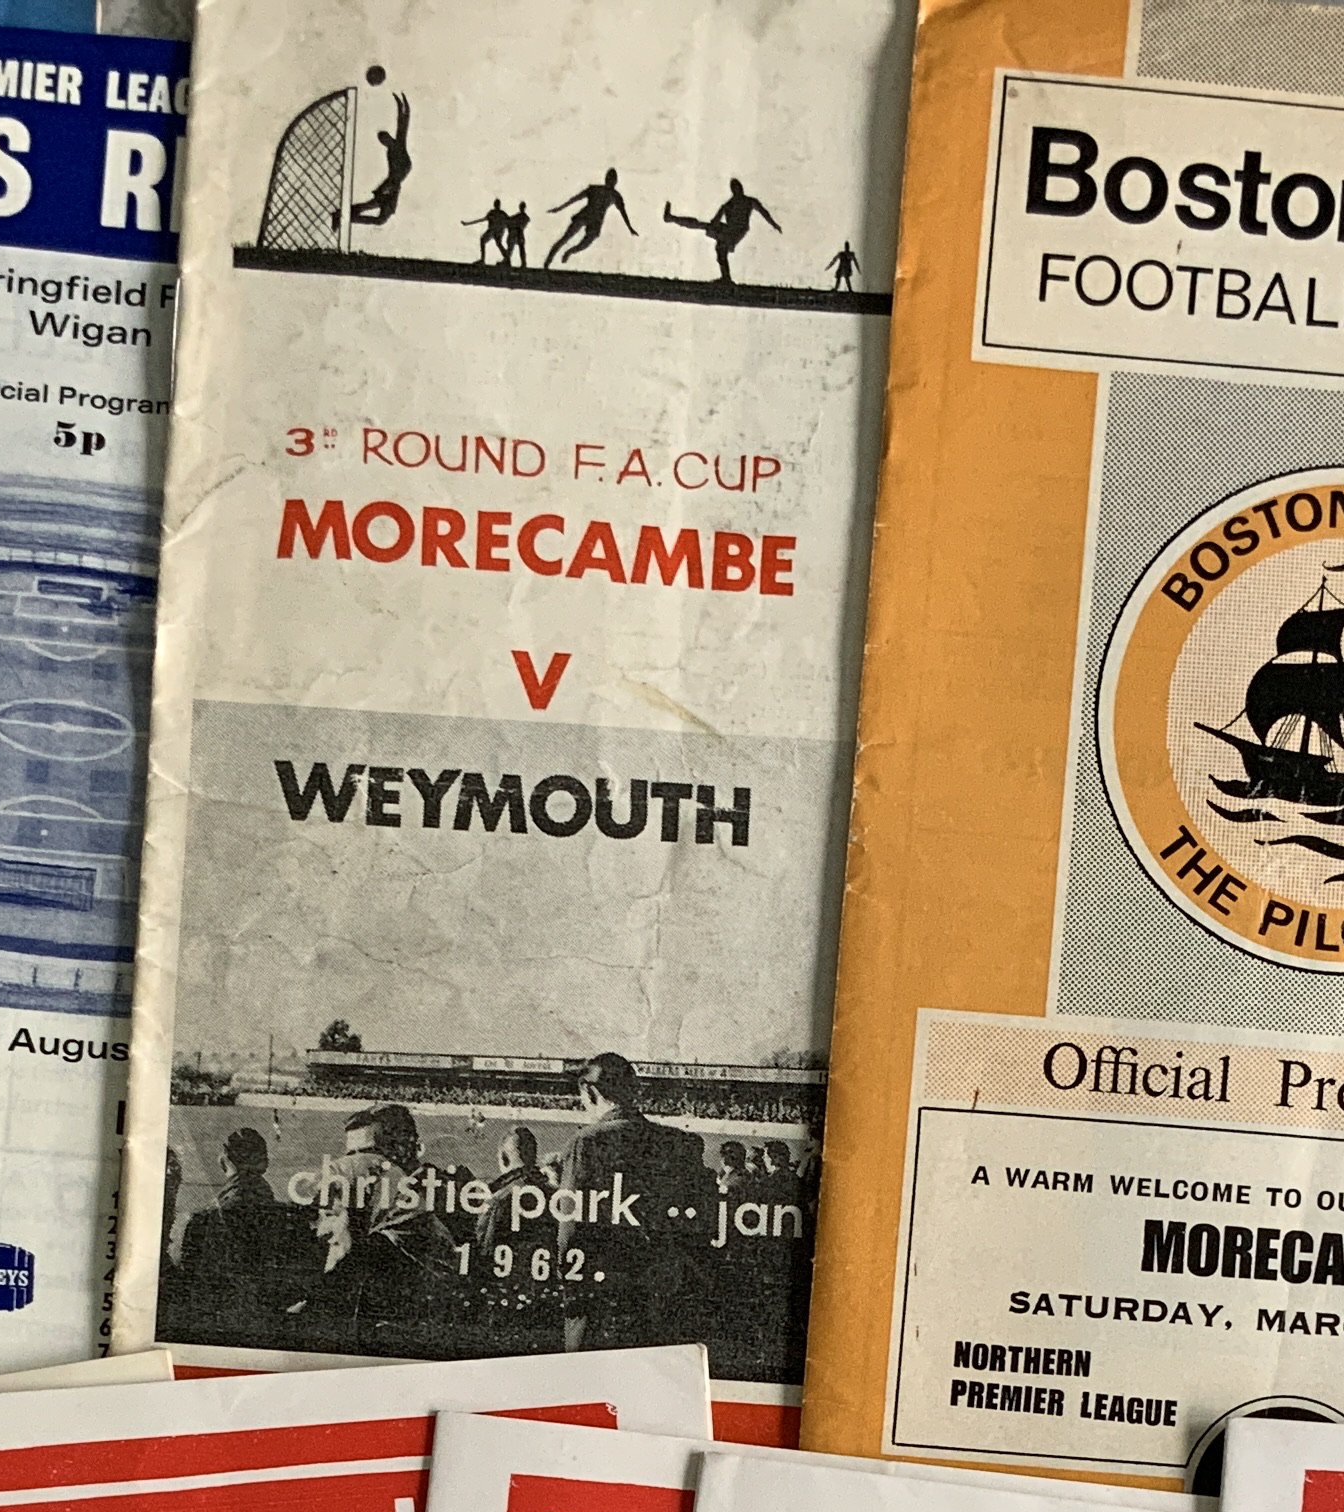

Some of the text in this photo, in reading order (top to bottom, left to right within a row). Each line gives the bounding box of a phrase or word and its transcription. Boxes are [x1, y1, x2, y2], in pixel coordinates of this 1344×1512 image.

[29, 305, 157, 352] Wigan
[54, 421, 105, 456] 5p
[363, 428, 545, 477] ROUND
[277, 499, 796, 596] MORECAMBE
[511, 650, 571, 710] V
[274, 760, 751, 846] WEYMOUTH
[1154, 825, 1247, 921] THE
[1044, 1042, 1230, 1102] Official
[288, 1153, 804, 1249] christie park jan
[971, 1166, 989, 1185] A
[1006, 1167, 1093, 1193] WARM
[1110, 1175, 1251, 1204] WELCOME
[1266, 1188, 1301, 1208] TO
[1009, 1291, 1232, 1330] SATURDAY,
[954, 1341, 1091, 1377] NORTHERN
[951, 1380, 1177, 1426] PREMIER LEAGUE
